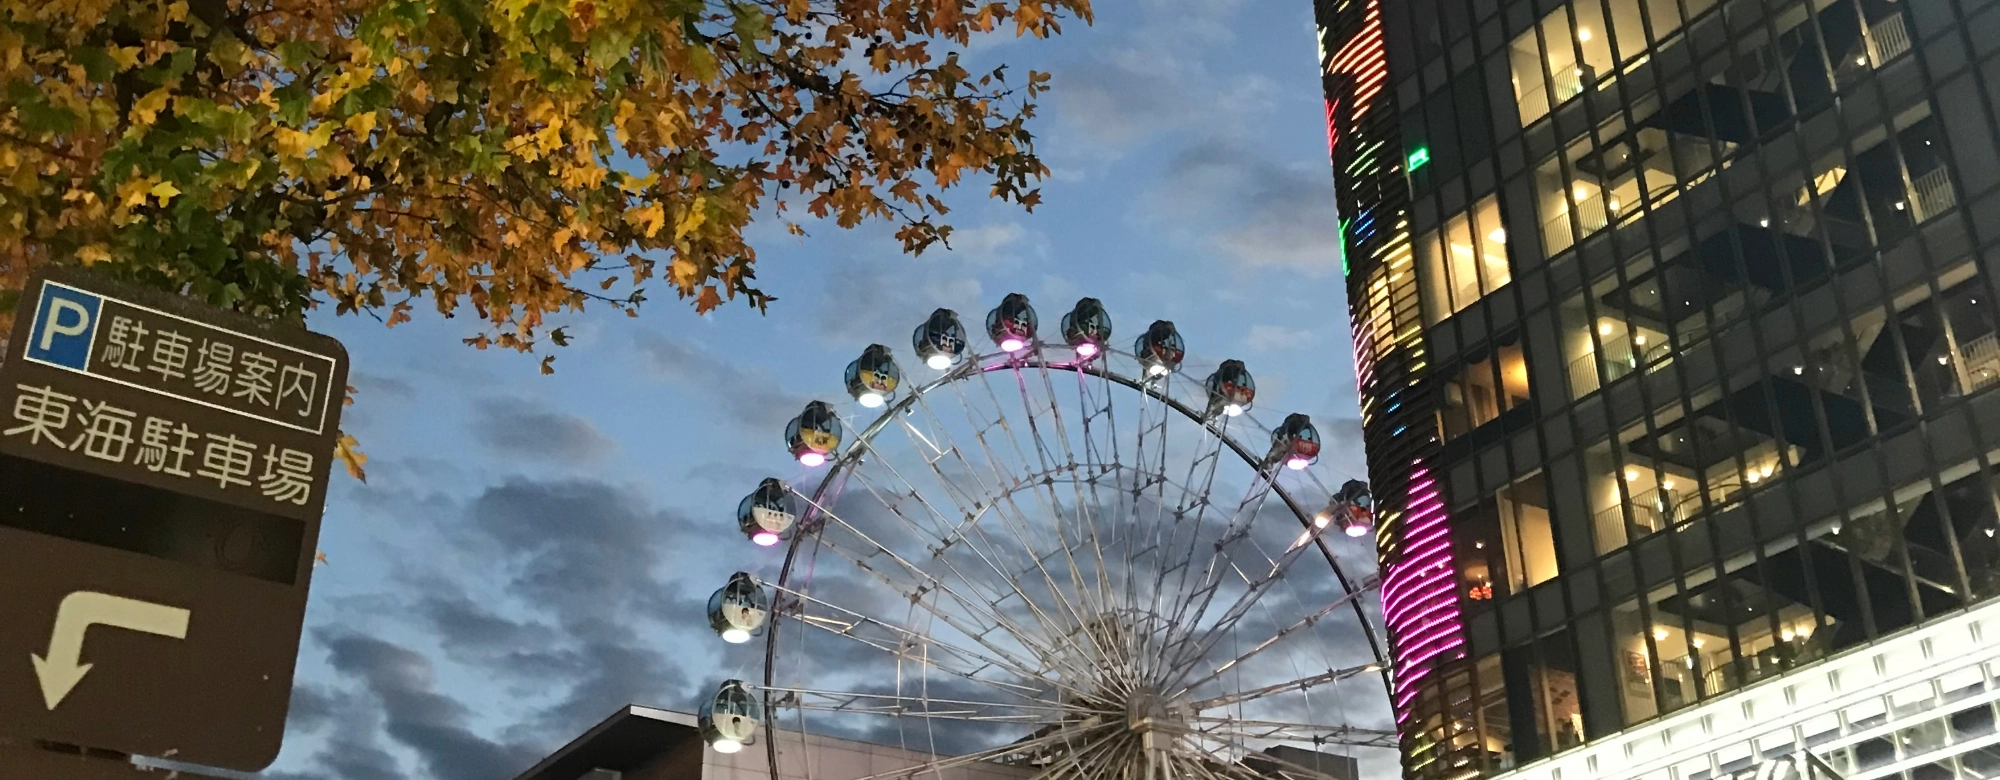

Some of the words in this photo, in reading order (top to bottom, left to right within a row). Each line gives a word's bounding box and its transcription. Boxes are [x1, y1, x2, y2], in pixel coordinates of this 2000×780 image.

[39, 296, 89, 351] P
[101, 315, 317, 417] 駐車場案内
[3, 383, 314, 506] 東海駐車場
